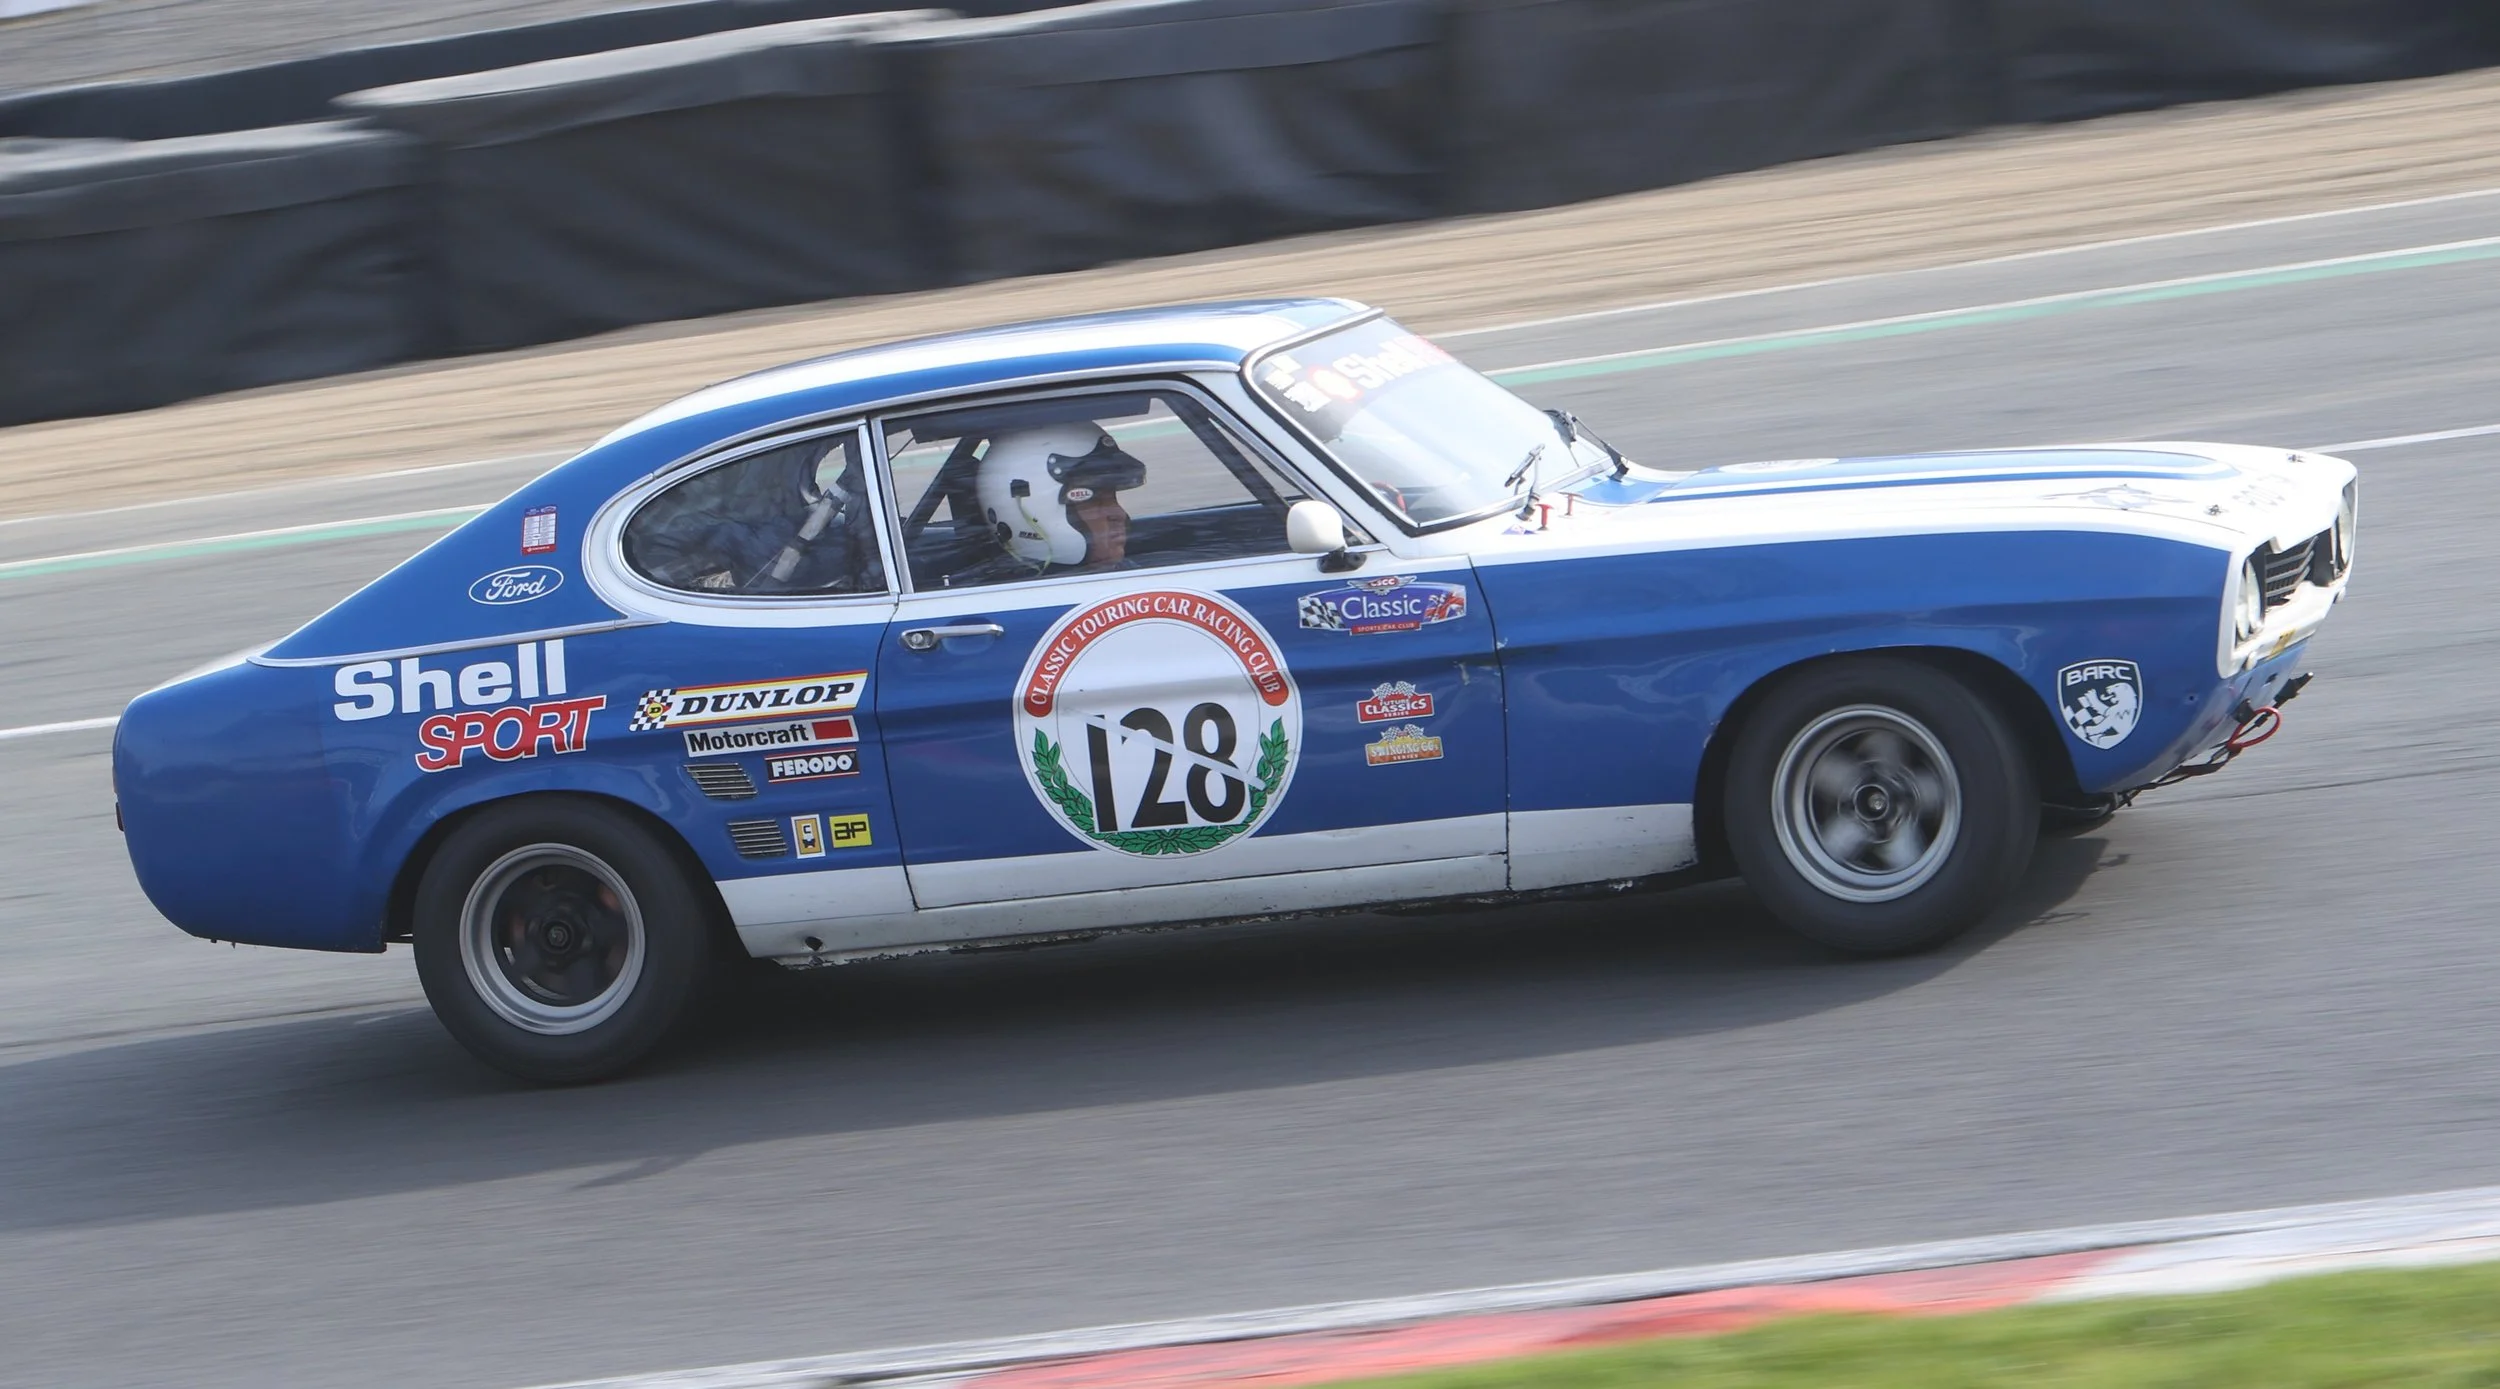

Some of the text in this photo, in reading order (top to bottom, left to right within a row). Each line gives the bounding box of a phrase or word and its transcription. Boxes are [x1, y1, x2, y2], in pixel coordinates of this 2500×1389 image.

[486, 572, 546, 600] Ford
[1341, 594, 1422, 620] Classic
[1030, 596, 1281, 705] CLASSIC TOURING CAR RACING CLUB
[334, 639, 567, 721] Shell
[2066, 665, 2132, 686] BARC
[676, 681, 855, 716] DUNLOP
[1365, 698, 1427, 715] CLASSICS
[415, 695, 607, 772] SPORT
[687, 723, 810, 752] Motorcraft
[772, 754, 853, 778] FERODO
[1086, 702, 1246, 832] 128
